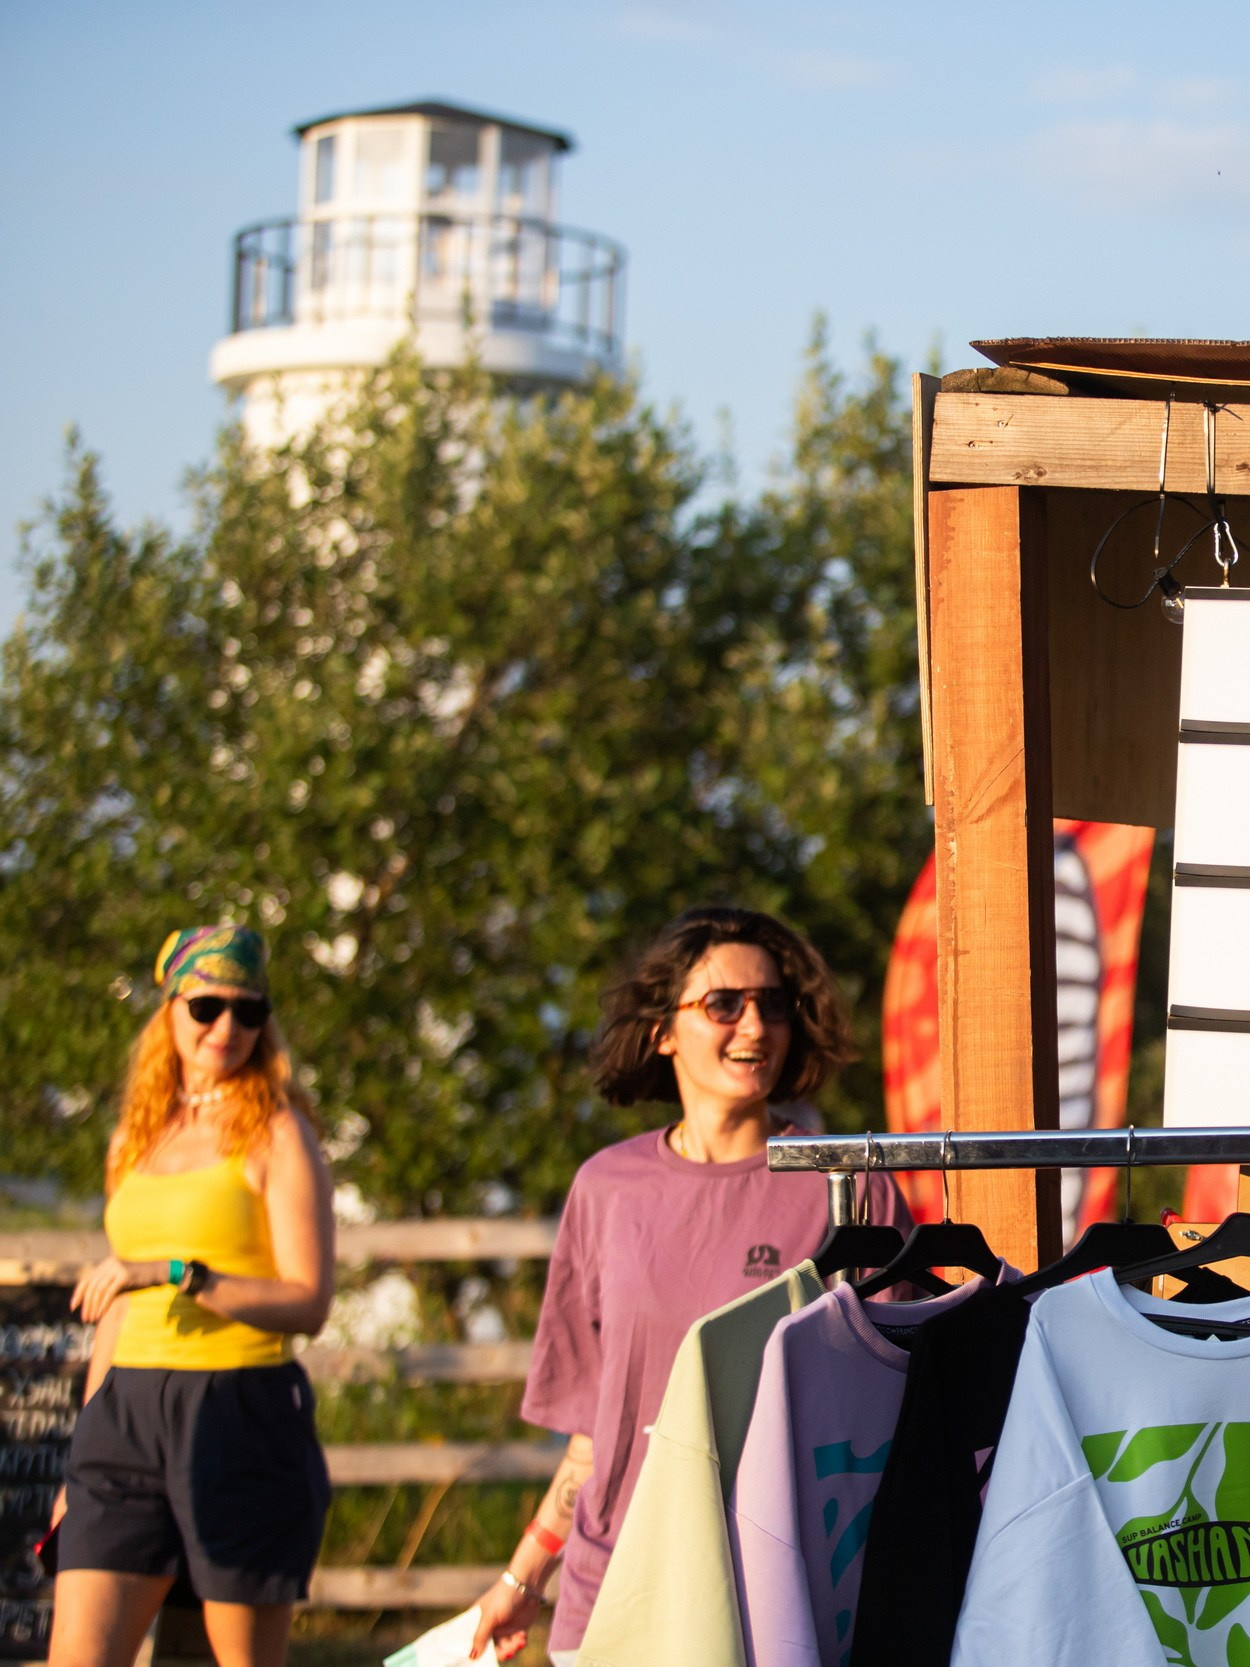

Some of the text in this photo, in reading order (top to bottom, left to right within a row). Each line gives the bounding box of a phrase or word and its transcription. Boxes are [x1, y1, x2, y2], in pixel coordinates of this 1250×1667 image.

[1122, 1513, 1202, 1544] SUP BALANCE CAMP
